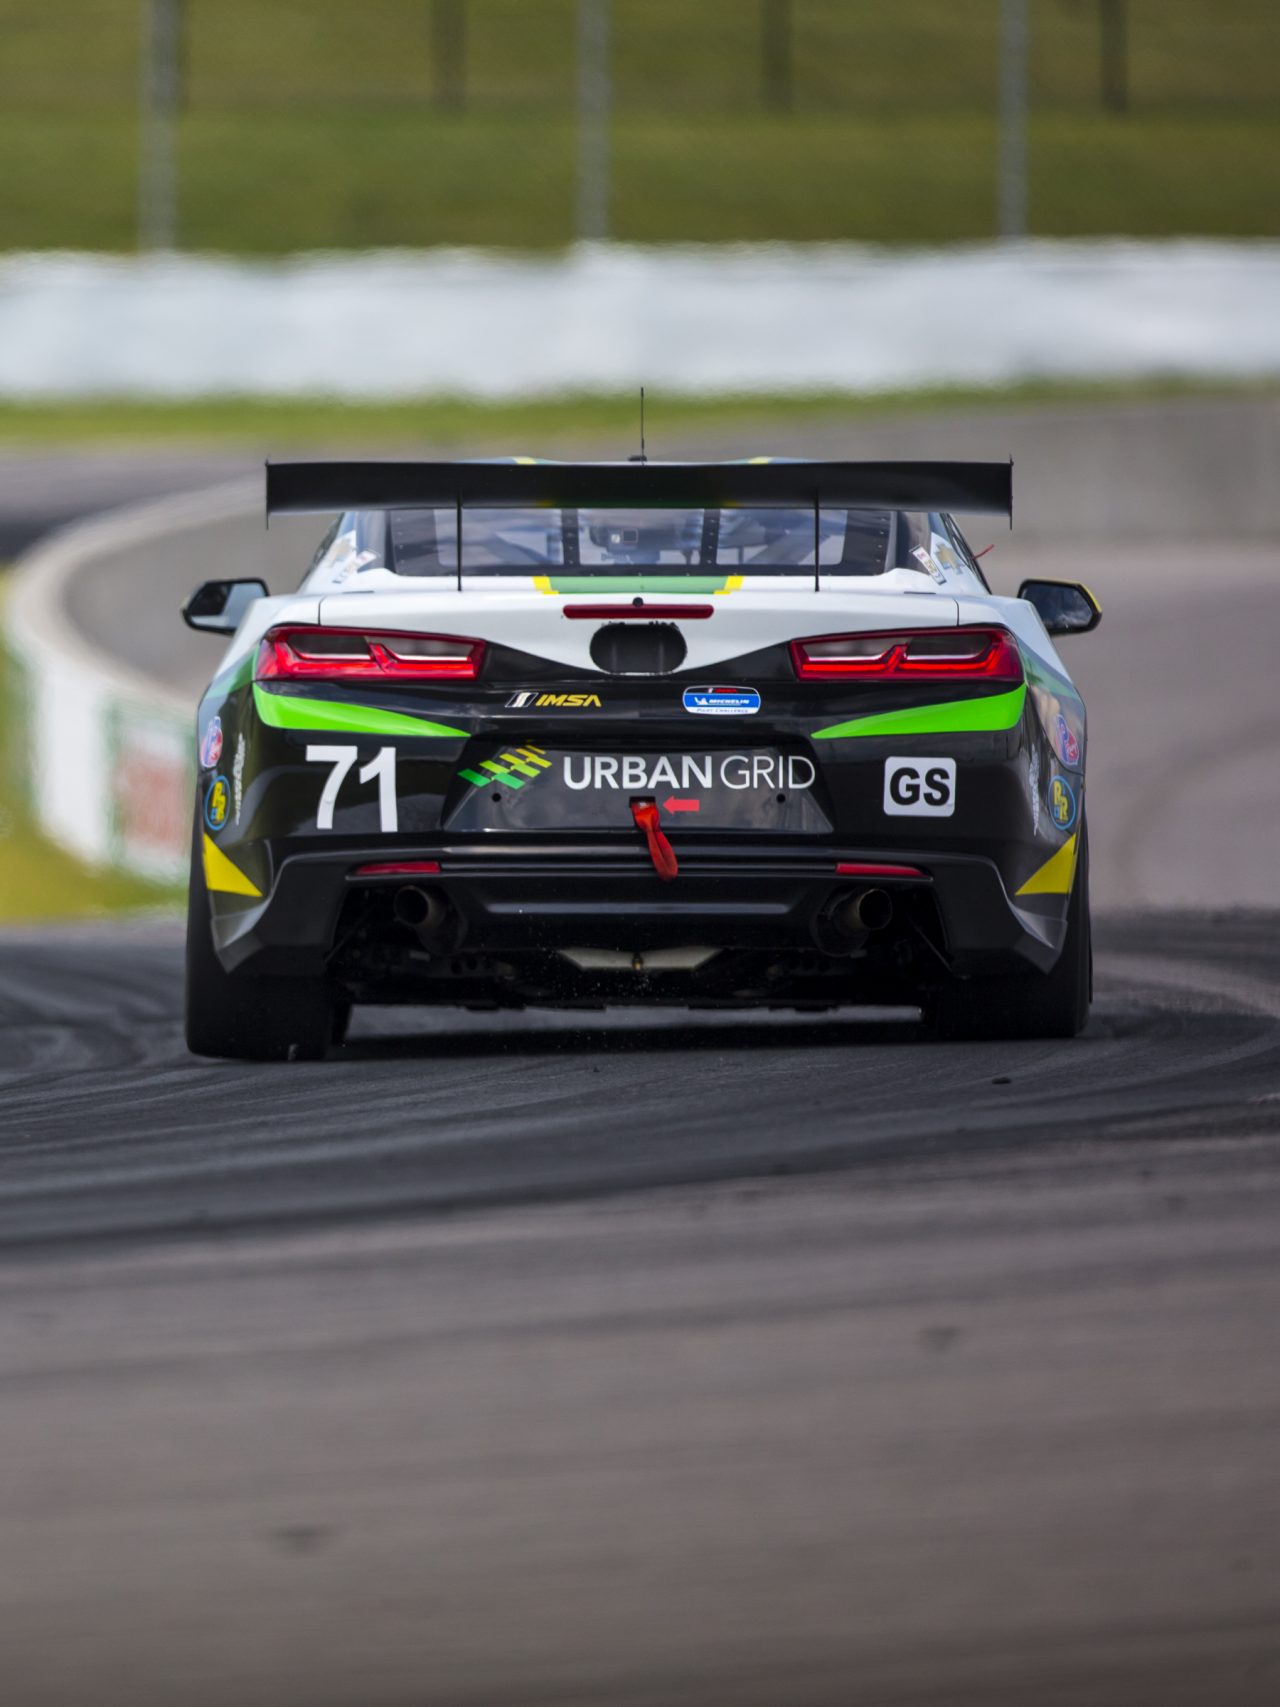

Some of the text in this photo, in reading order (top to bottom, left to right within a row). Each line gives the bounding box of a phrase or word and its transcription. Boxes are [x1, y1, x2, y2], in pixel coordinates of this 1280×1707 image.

[535, 694, 601, 707] IMSA
[305, 744, 398, 833] 71
[562, 755, 816, 790] URBAN GRID
[889, 767, 951, 807] GS
